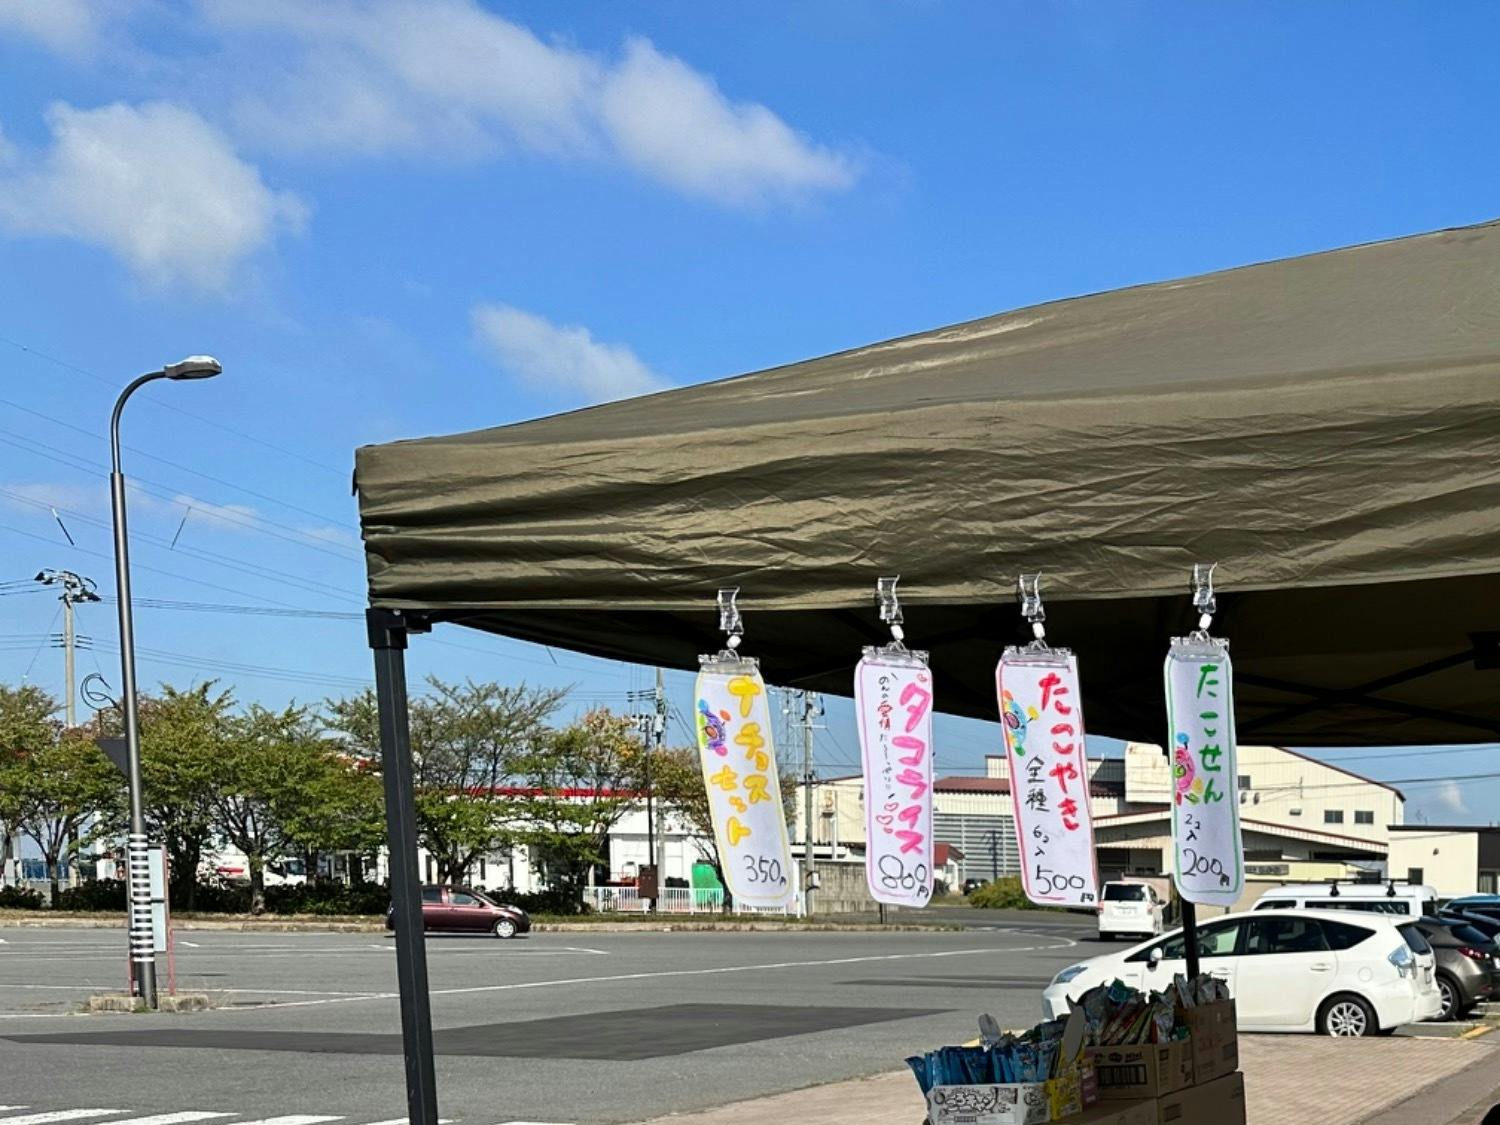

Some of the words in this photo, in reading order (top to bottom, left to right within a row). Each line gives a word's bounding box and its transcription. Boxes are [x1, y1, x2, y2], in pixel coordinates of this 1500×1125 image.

[727, 675, 772, 804] ナチョス
[892, 682, 931, 855] タコライス
[1039, 672, 1079, 831] たこやき
[1196, 663, 1224, 805] たこせん
[710, 764, 752, 847] セット
